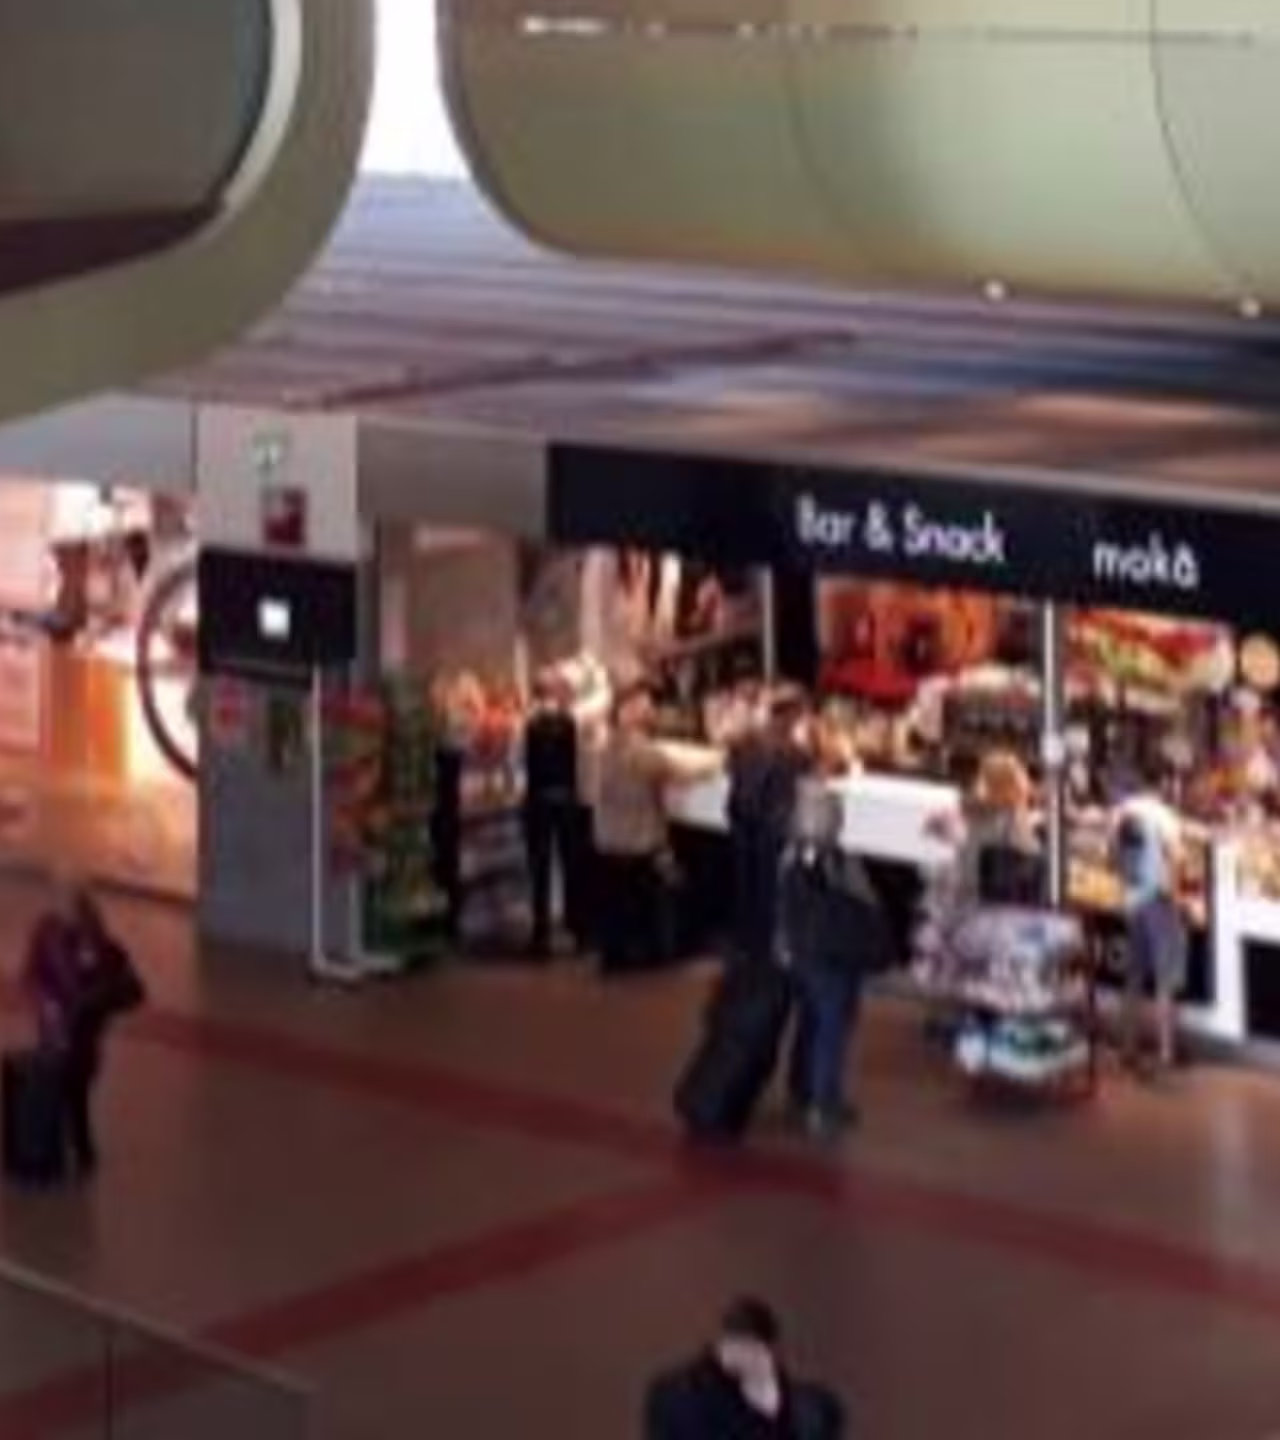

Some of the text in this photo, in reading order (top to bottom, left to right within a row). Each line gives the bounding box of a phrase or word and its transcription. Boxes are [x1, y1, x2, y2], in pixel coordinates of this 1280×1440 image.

[795, 492, 1006, 564] Bar & Snack
